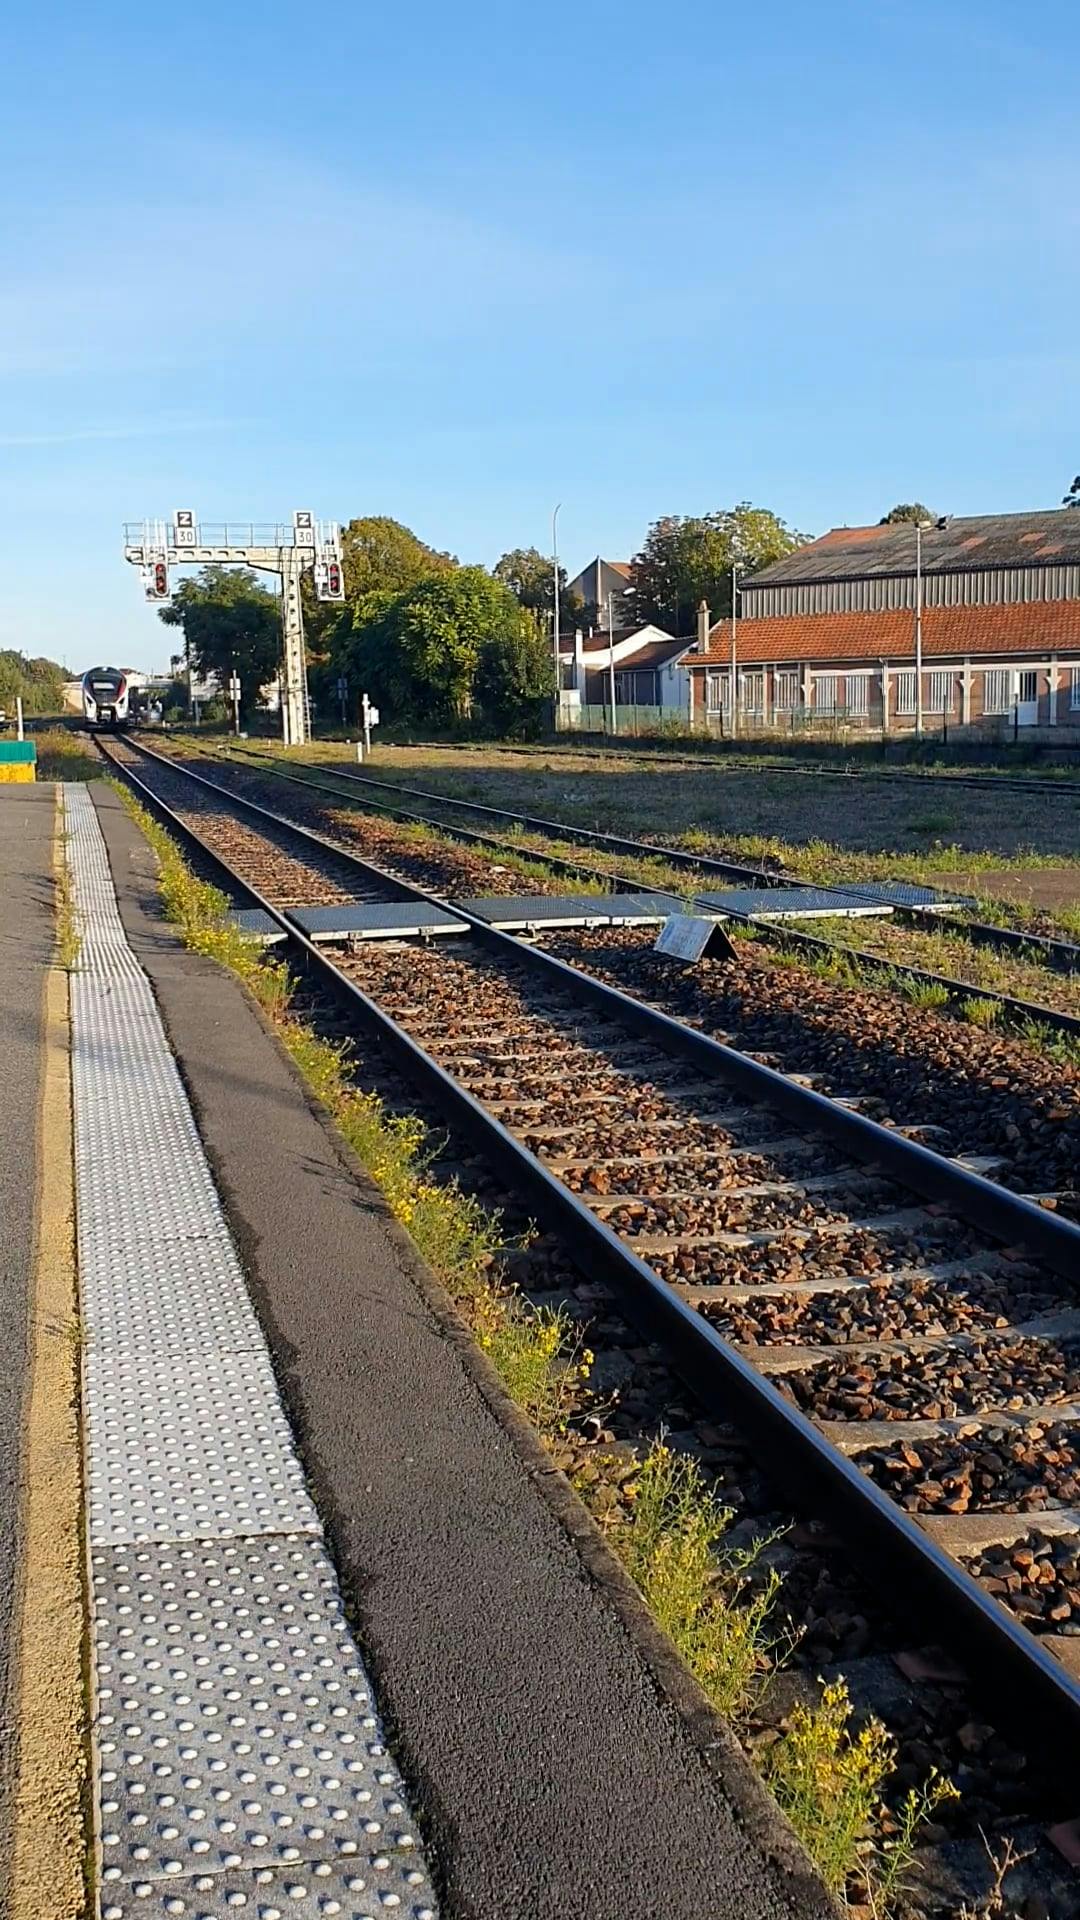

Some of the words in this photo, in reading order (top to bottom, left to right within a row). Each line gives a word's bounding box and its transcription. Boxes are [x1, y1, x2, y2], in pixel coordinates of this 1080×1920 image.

[179, 513, 191, 525] Z
[297, 514, 309, 526] Z
[179, 531, 193, 543] 30
[298, 531, 312, 543] 30
